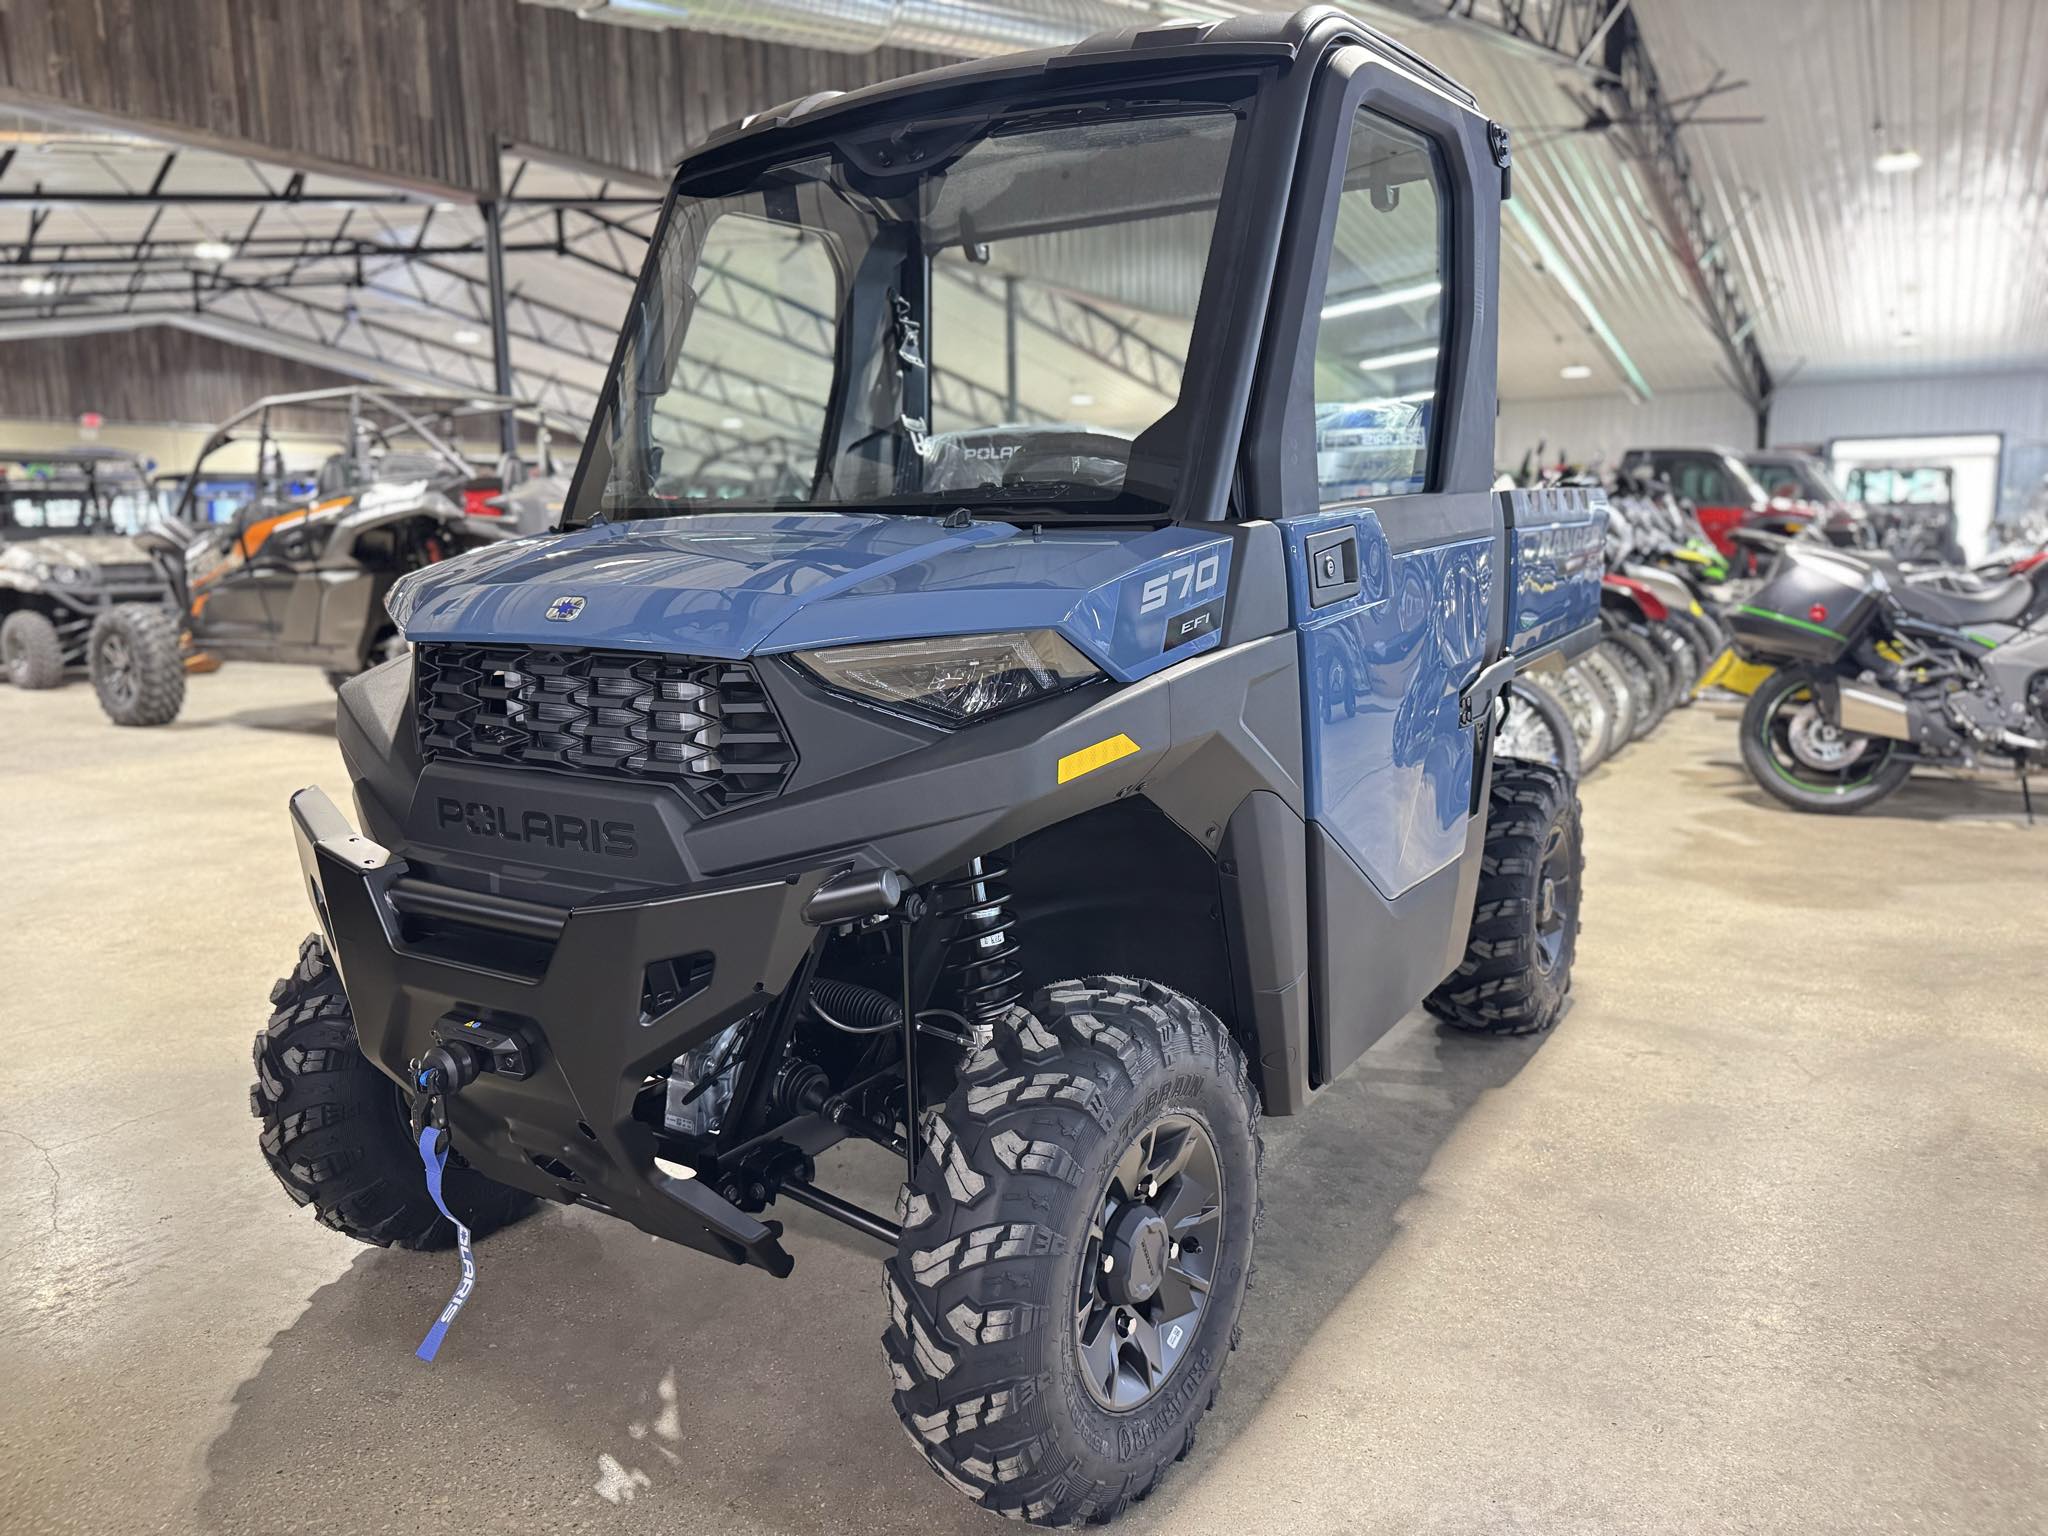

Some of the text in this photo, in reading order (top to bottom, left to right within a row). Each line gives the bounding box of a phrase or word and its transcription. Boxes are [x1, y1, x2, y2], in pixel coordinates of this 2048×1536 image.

[1141, 555, 1219, 615] 570
[1181, 612, 1210, 634] EFI
[436, 797, 639, 858] POLARIS
